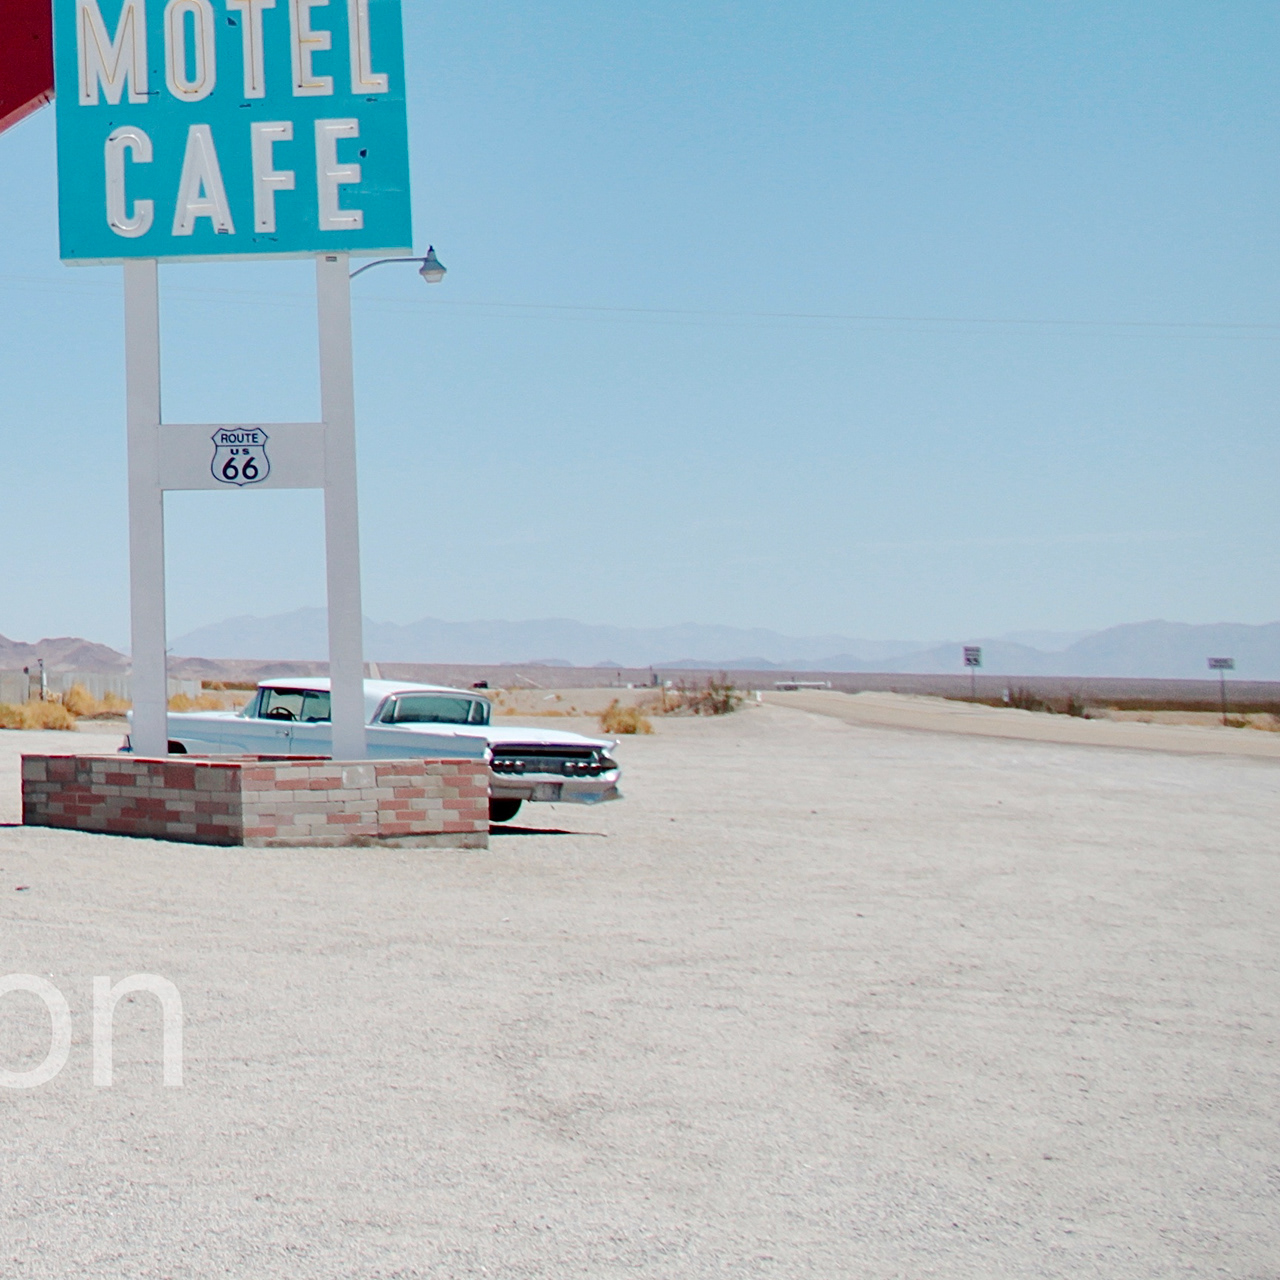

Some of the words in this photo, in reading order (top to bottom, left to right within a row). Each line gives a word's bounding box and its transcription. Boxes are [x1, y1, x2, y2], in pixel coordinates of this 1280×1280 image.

[104, 118, 364, 238] CAFE
[221, 433, 259, 443] ROUTE
[222, 456, 259, 480] 66
